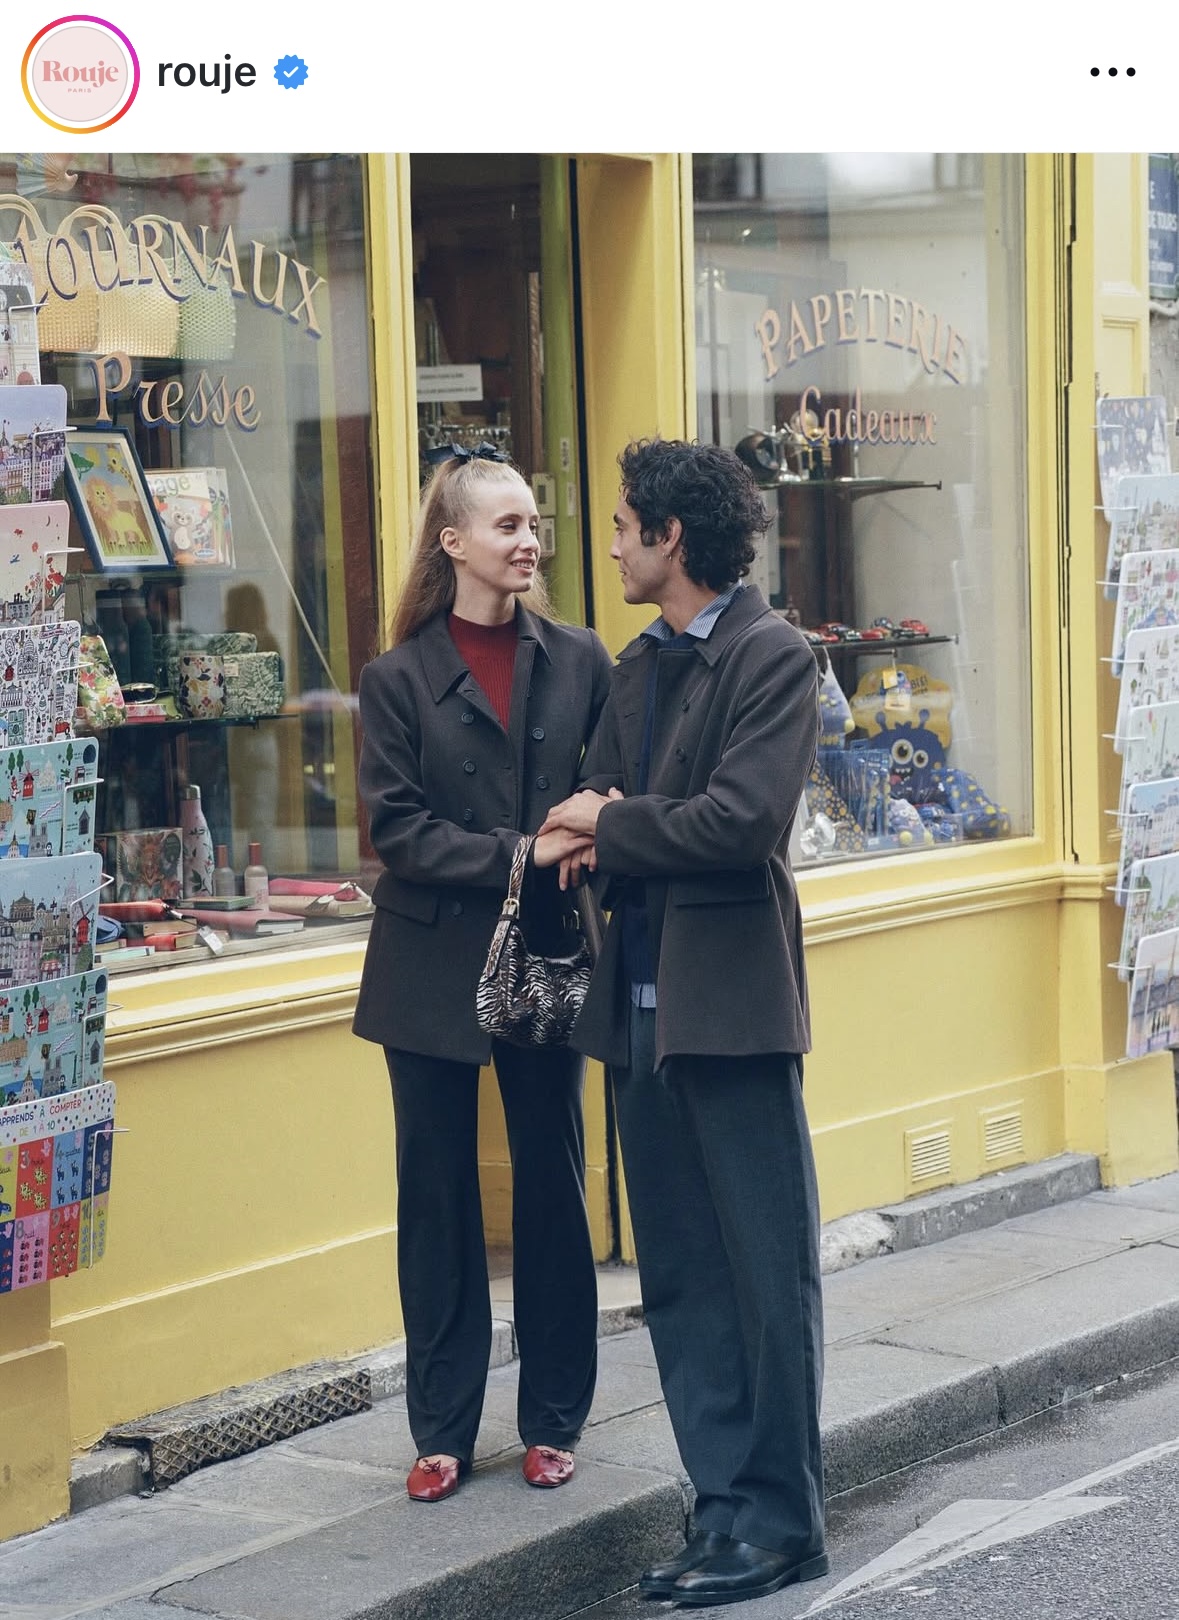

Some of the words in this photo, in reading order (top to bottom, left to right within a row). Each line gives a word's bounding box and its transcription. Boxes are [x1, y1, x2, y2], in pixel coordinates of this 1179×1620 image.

[754, 286, 968, 384] PAPETERIE
[87, 351, 262, 431] Presse
[799, 384, 938, 446] Cadeaux
[49, 1099, 82, 1115] COMPTER
[20, 1127, 29, 1137] DE
[47, 1120, 56, 1131] 10
[20, 1150, 30, 1170] 3
[16, 1220, 25, 1240] 8
